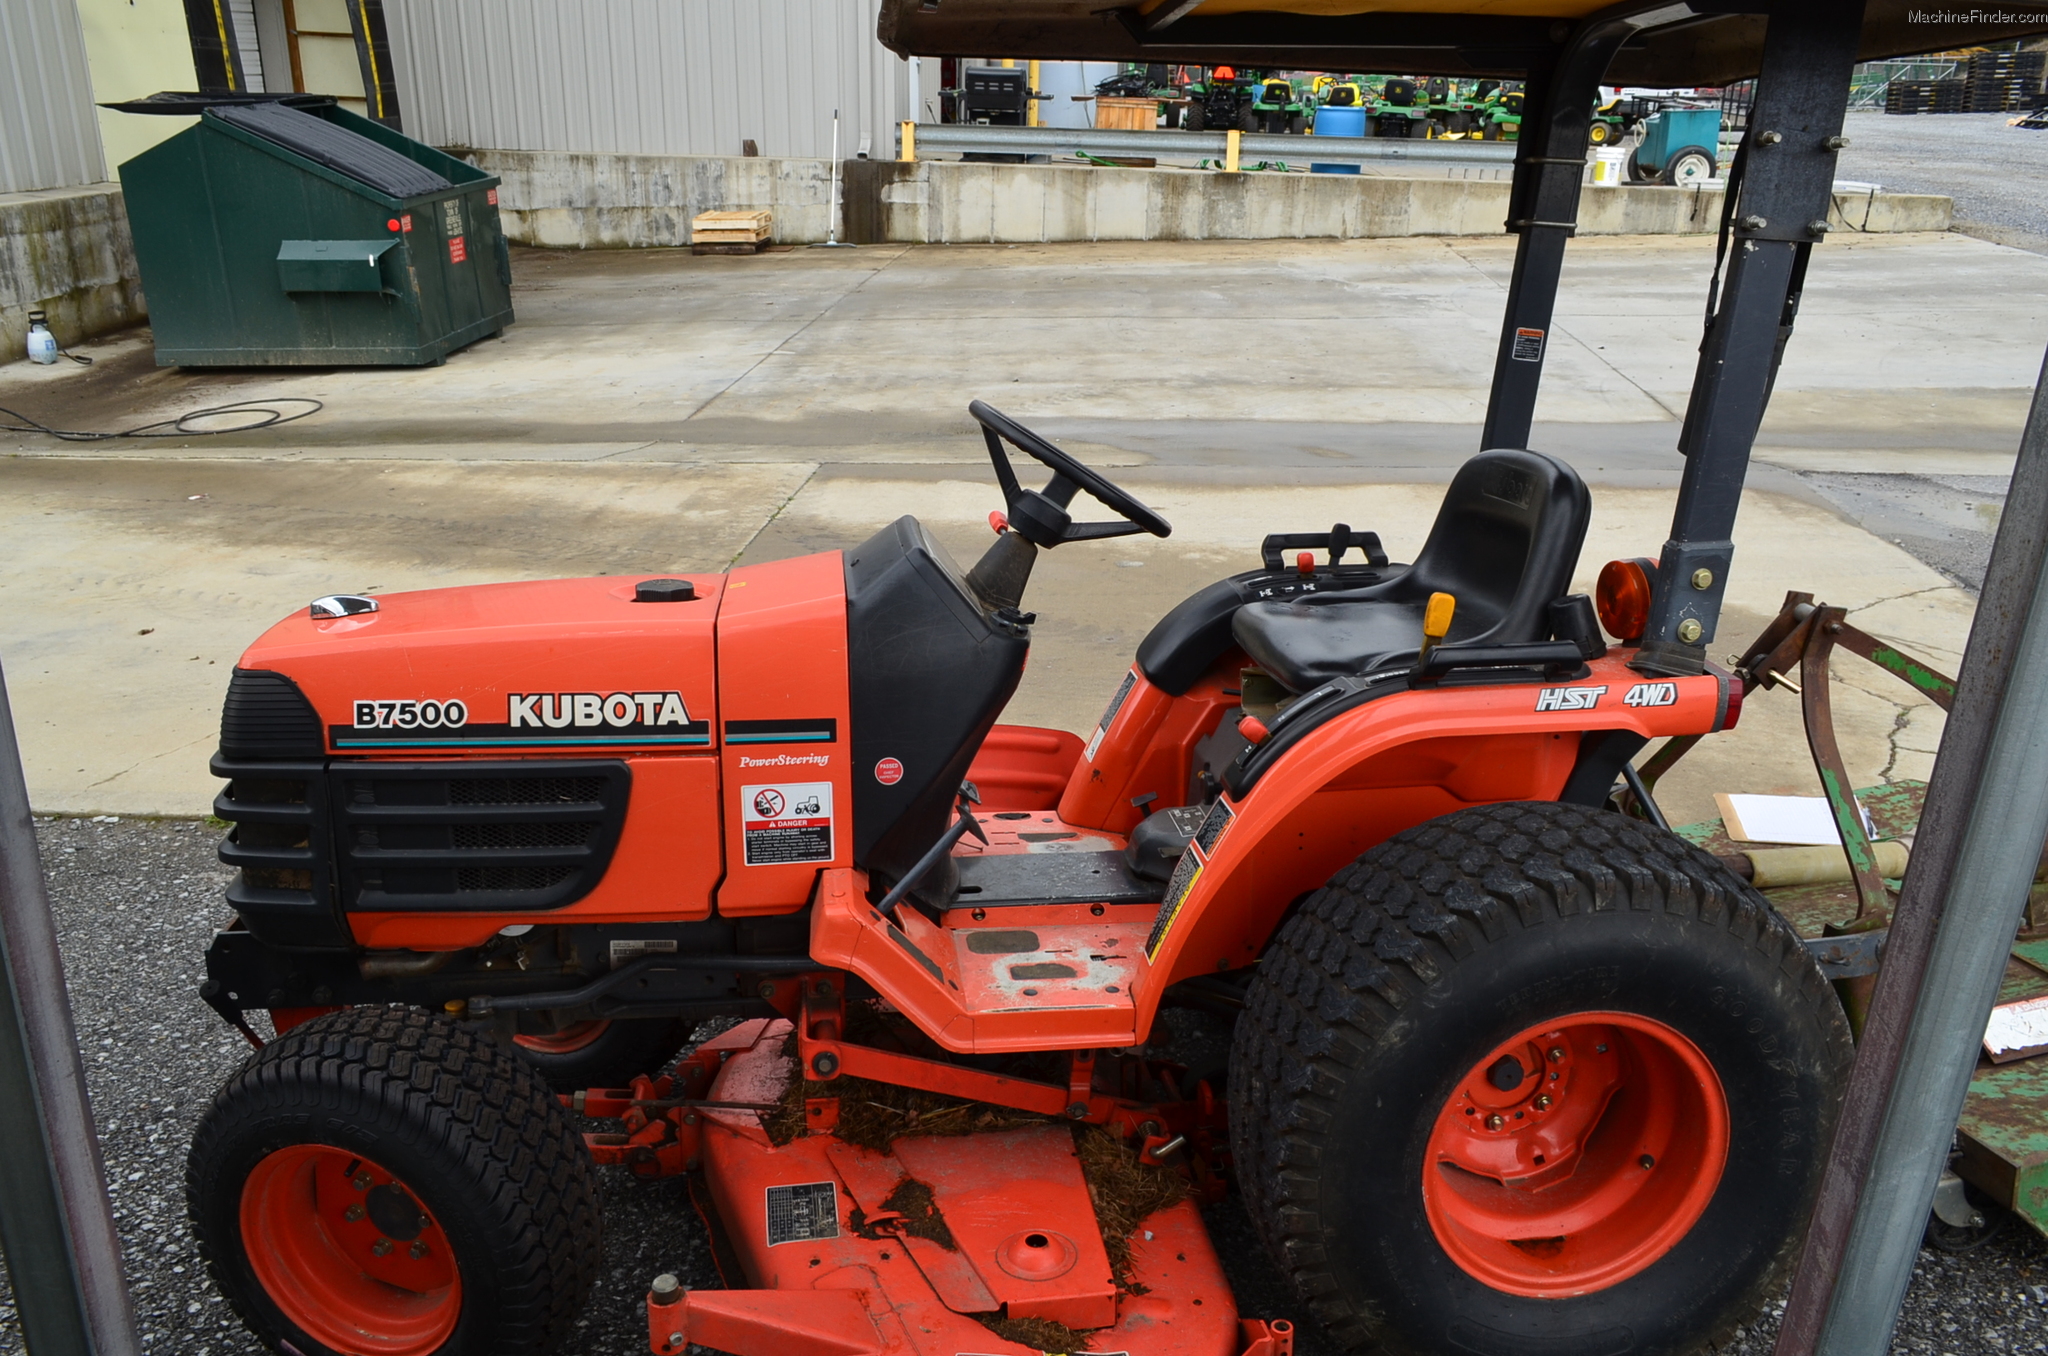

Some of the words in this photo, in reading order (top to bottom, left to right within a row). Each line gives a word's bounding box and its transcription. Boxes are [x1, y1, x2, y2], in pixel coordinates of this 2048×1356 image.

[353, 699, 469, 729] B7500
[508, 693, 690, 728] KUBOTA
[1535, 685, 1608, 712] HST
[1623, 682, 1677, 708] 4WD
[739, 753, 830, 768] PowerSteering
[777, 819, 808, 827] DANGER
[1709, 985, 1801, 1176] GOODYEAR
